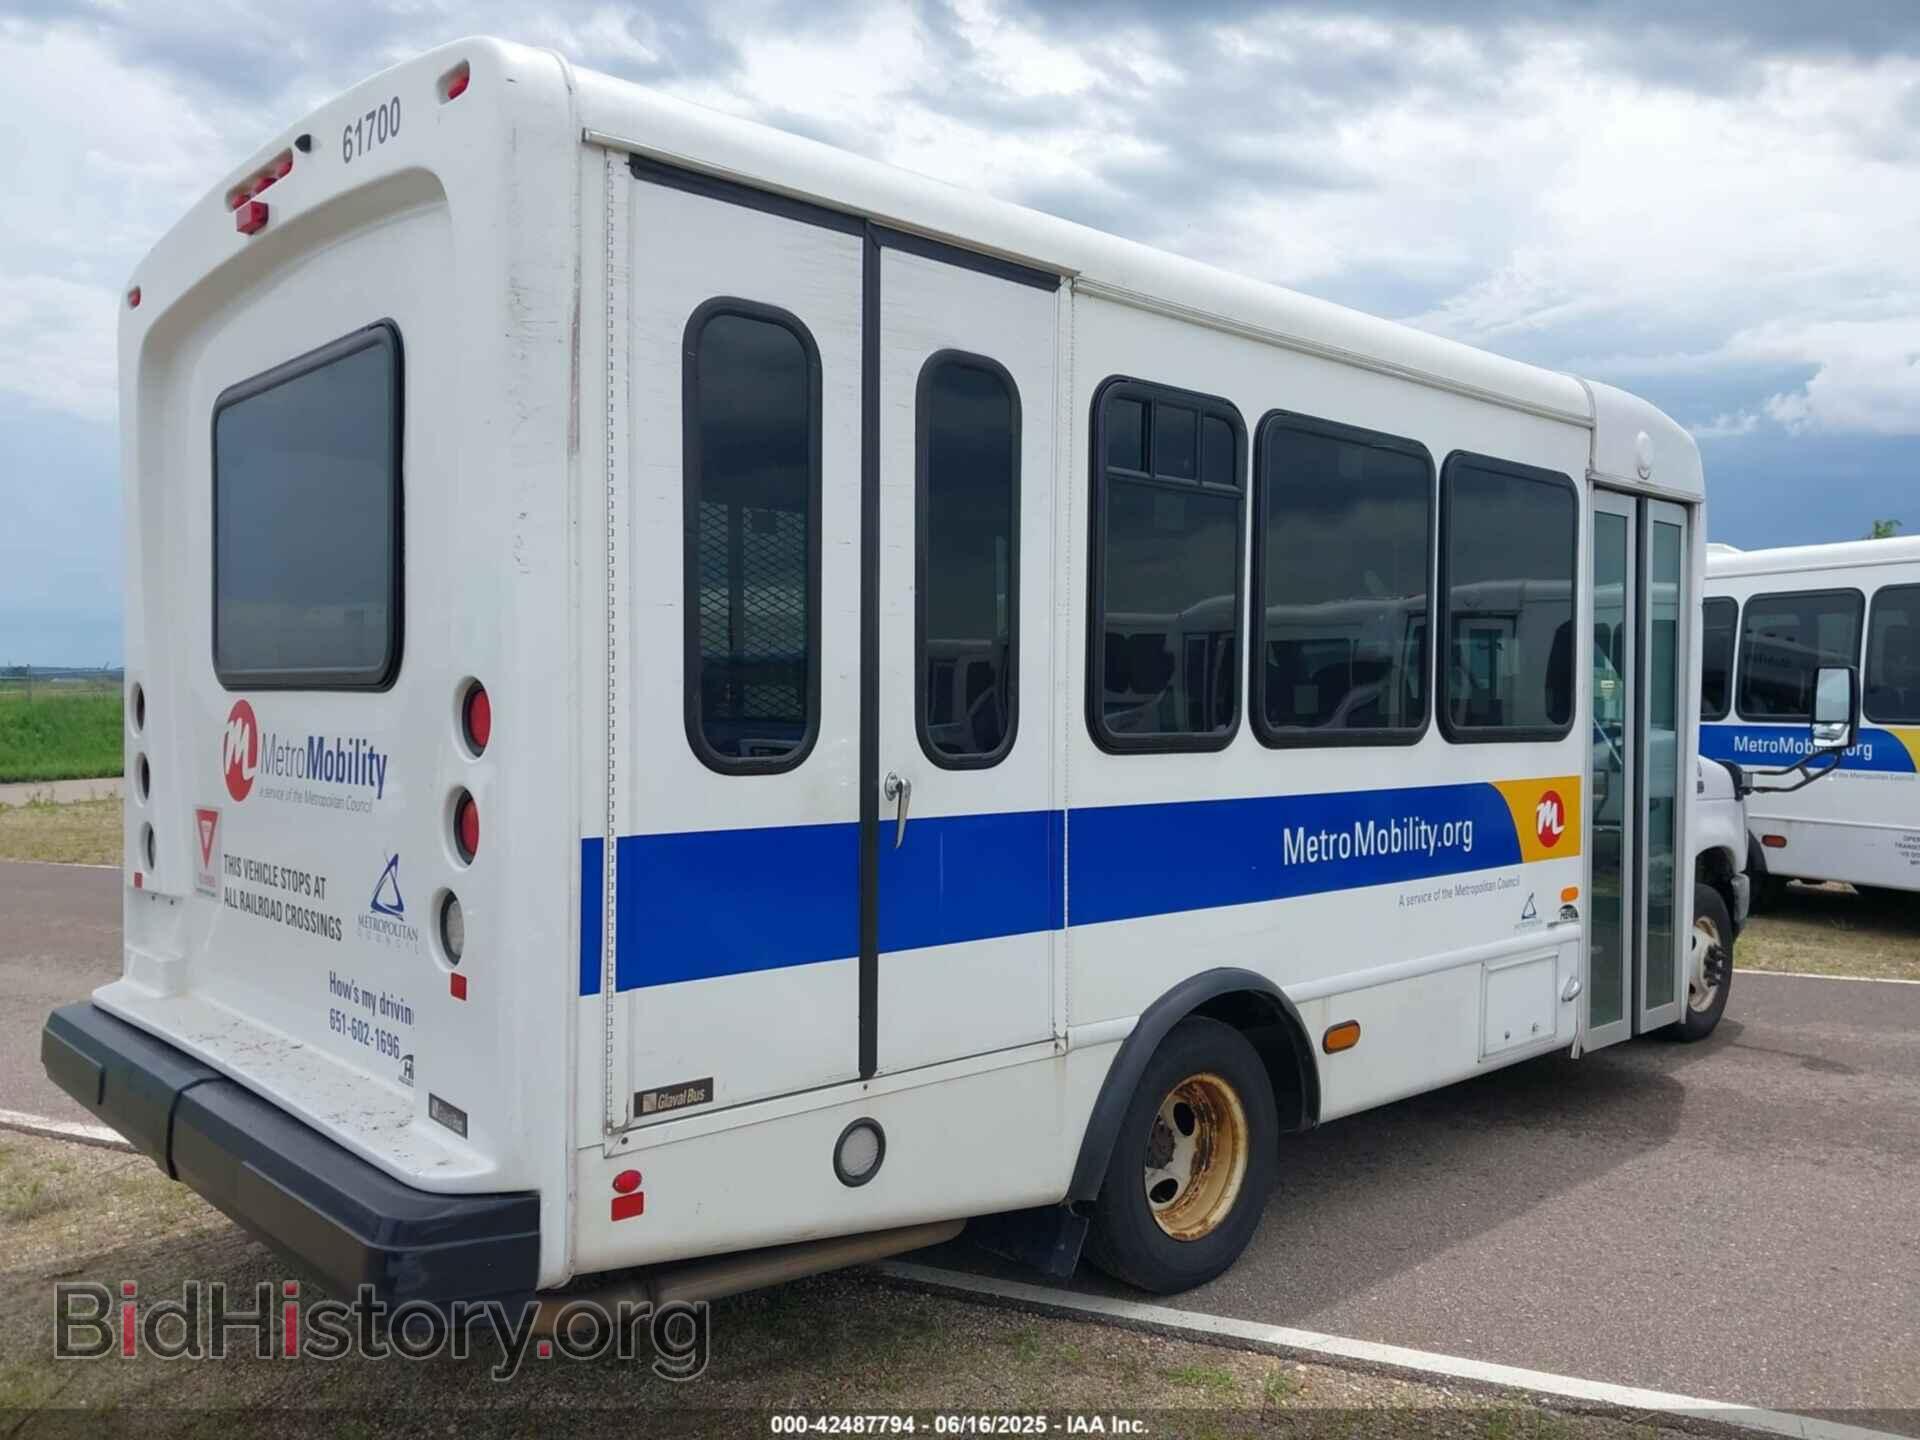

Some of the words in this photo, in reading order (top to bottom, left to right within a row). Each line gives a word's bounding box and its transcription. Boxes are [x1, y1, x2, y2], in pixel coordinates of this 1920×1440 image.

[343, 95, 401, 164] 61700
[1282, 816, 1473, 866] MetroMobility.org
[224, 853, 242, 878] THIS
[243, 857, 279, 888] VEHICLE
[280, 866, 312, 897] STOPS
[313, 874, 327, 901] AT
[224, 885, 238, 910] ALL
[240, 889, 282, 923] RAILROAD
[285, 902, 343, 942] CROSSINGS
[329, 970, 359, 1005] How's
[361, 989, 377, 1017] my
[379, 991, 415, 1031] drivin
[329, 1007, 400, 1060] 651-602-1696
